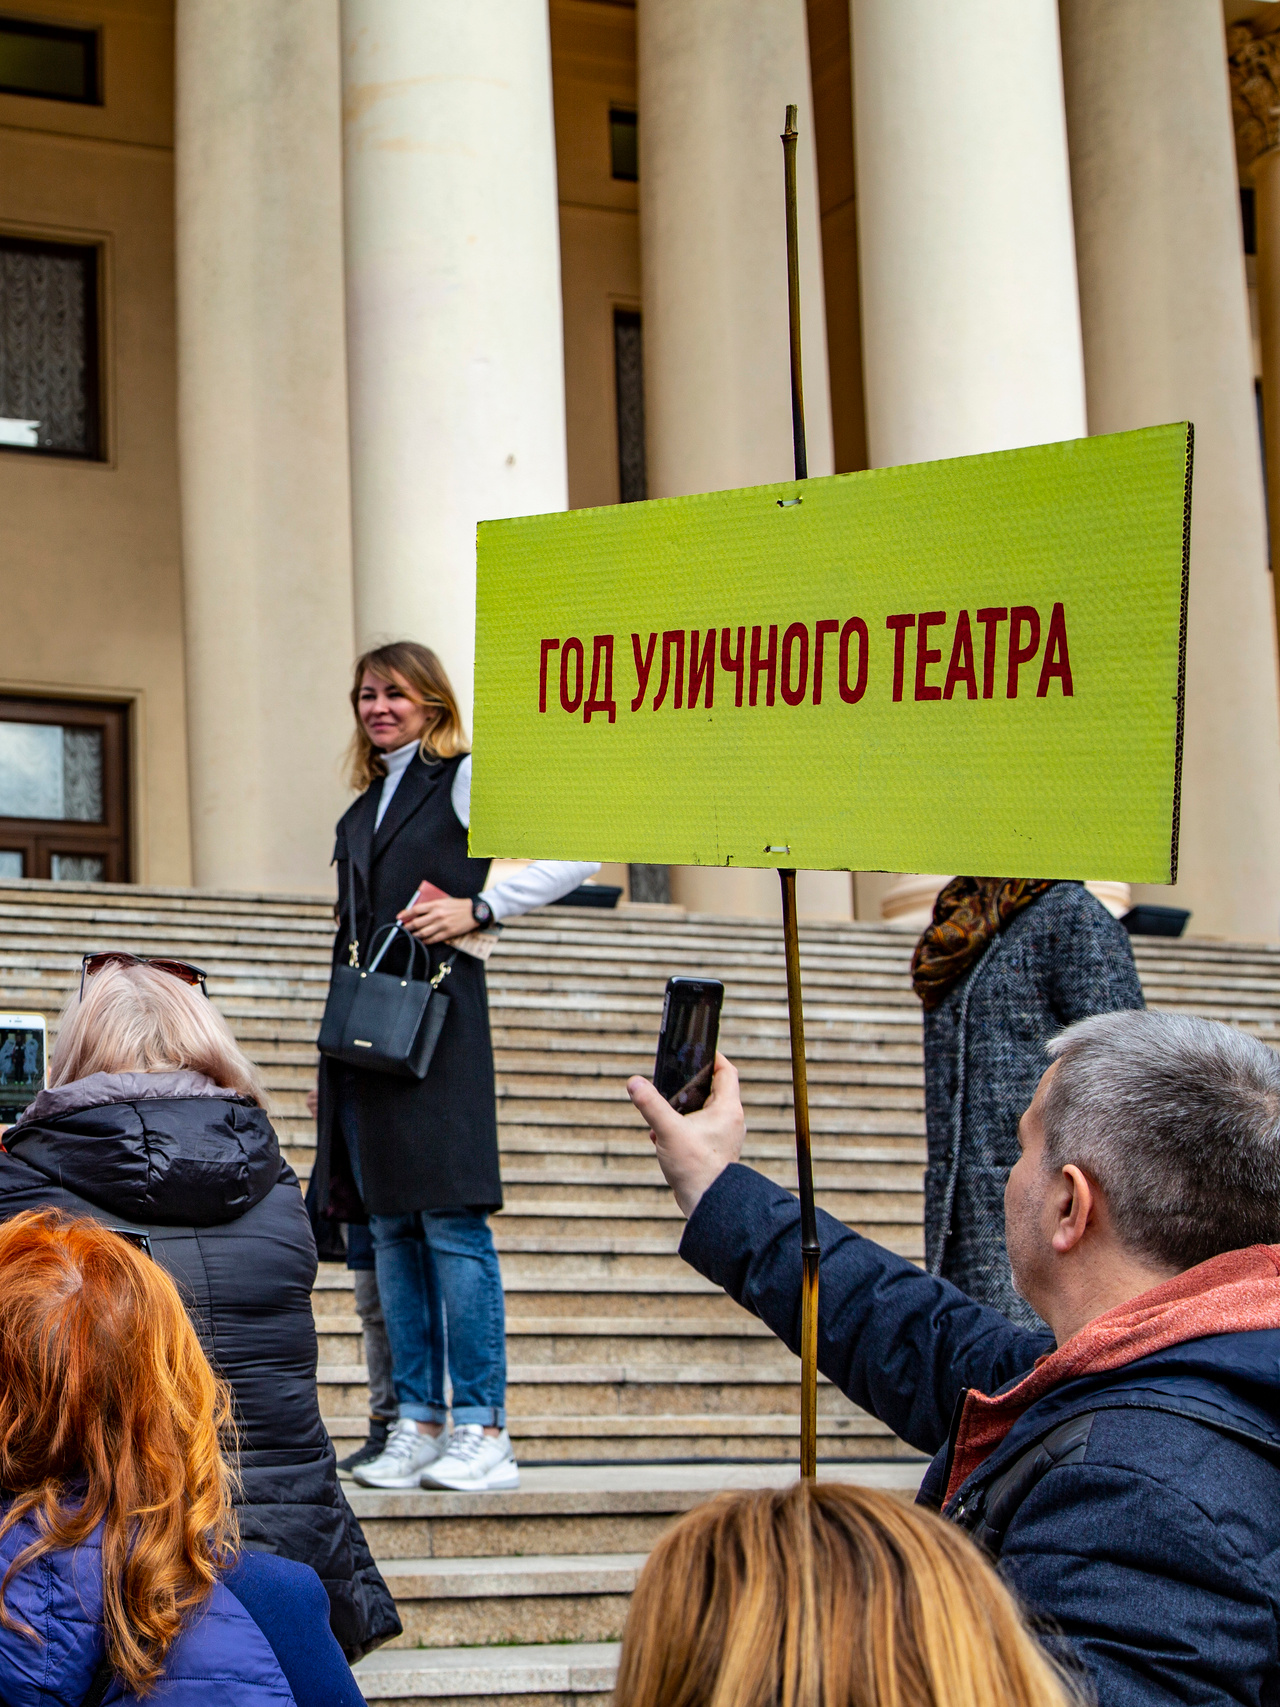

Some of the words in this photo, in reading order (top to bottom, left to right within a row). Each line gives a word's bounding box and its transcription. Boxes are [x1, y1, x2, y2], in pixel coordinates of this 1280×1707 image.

[538, 634, 616, 723] ГОД
[630, 616, 869, 712] УЛИЧНОГО
[886, 602, 1073, 702] ТЕАТРА
